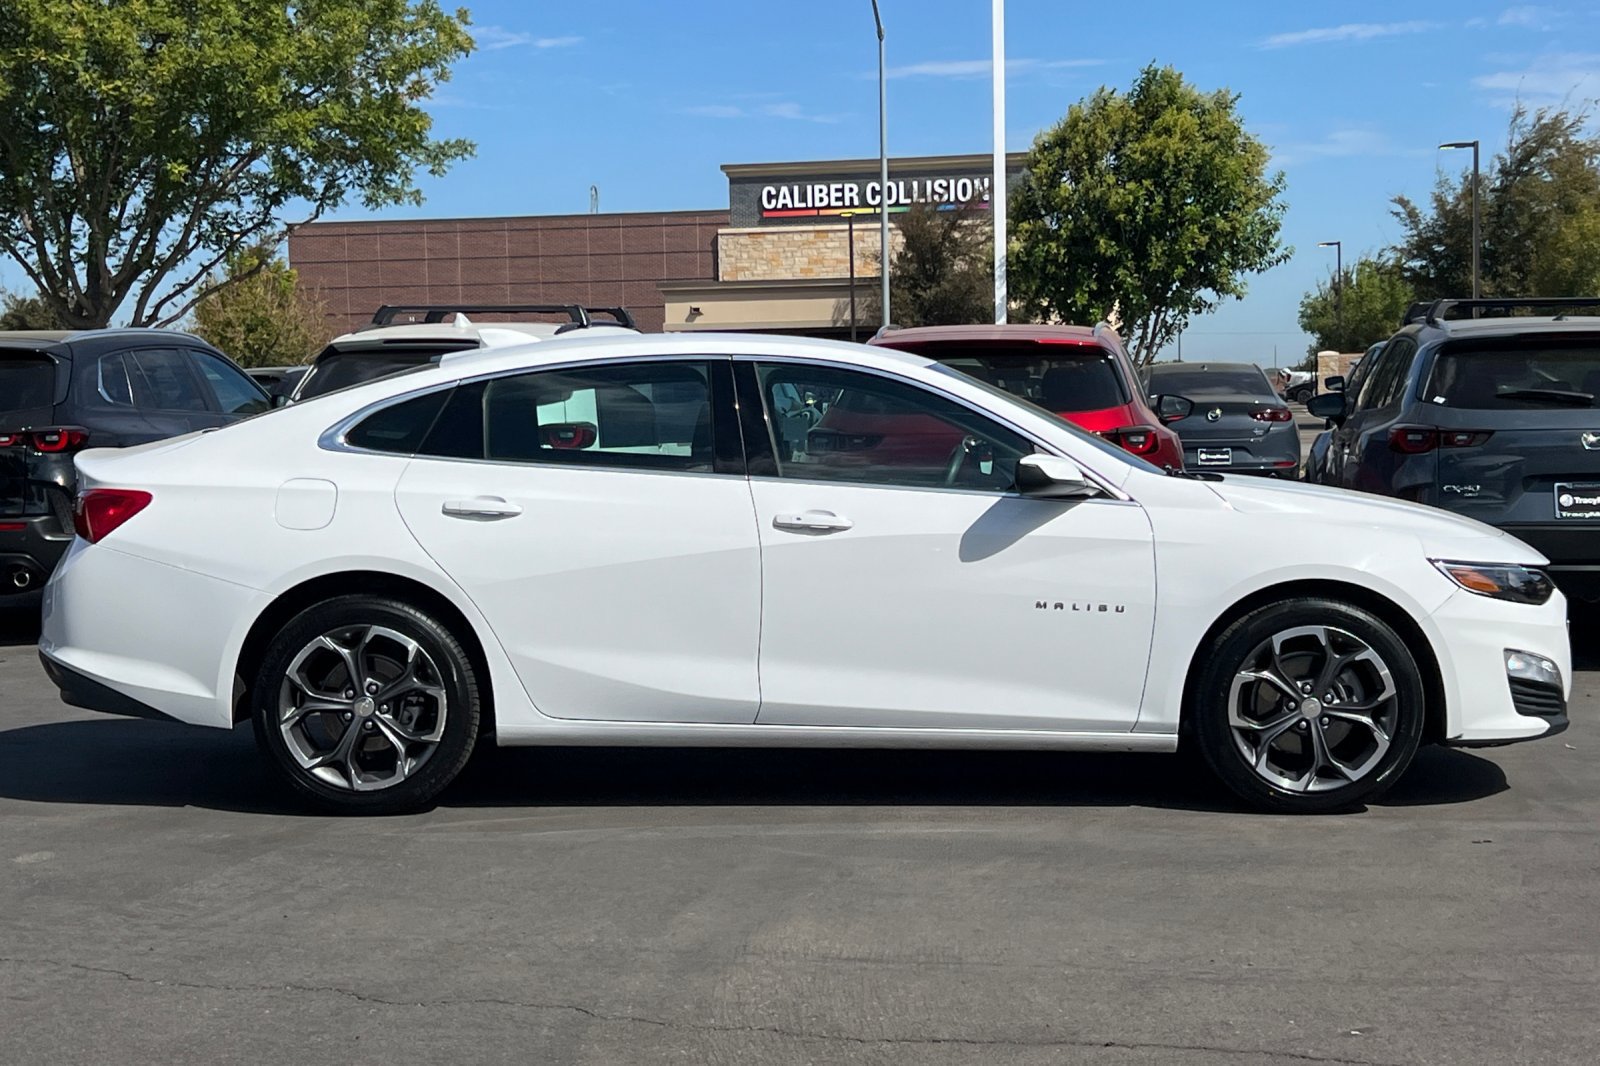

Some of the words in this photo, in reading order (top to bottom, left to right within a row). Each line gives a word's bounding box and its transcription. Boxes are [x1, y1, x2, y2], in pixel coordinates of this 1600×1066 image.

[761, 183, 860, 210] CALIBER
[866, 178, 990, 206] COLLISION
[1035, 601, 1125, 613] MALIBU
